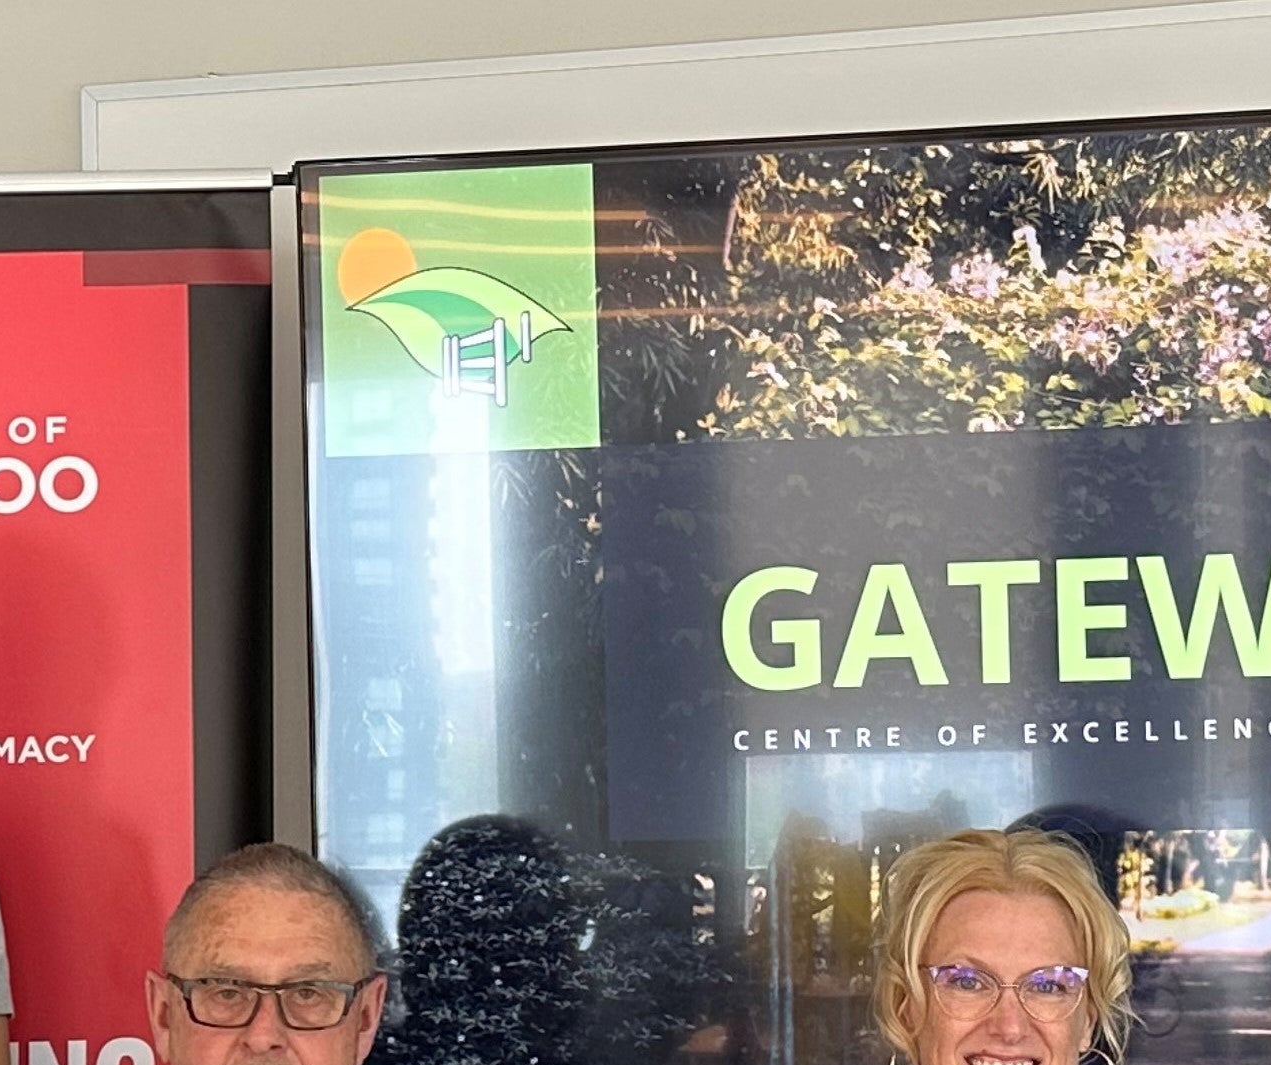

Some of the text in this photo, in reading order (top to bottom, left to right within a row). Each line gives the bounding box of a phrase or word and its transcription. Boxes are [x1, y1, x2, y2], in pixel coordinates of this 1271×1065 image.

[8, 416, 68, 445] OF
[733, 726, 901, 751] CENTRE
[937, 724, 986, 747] OF
